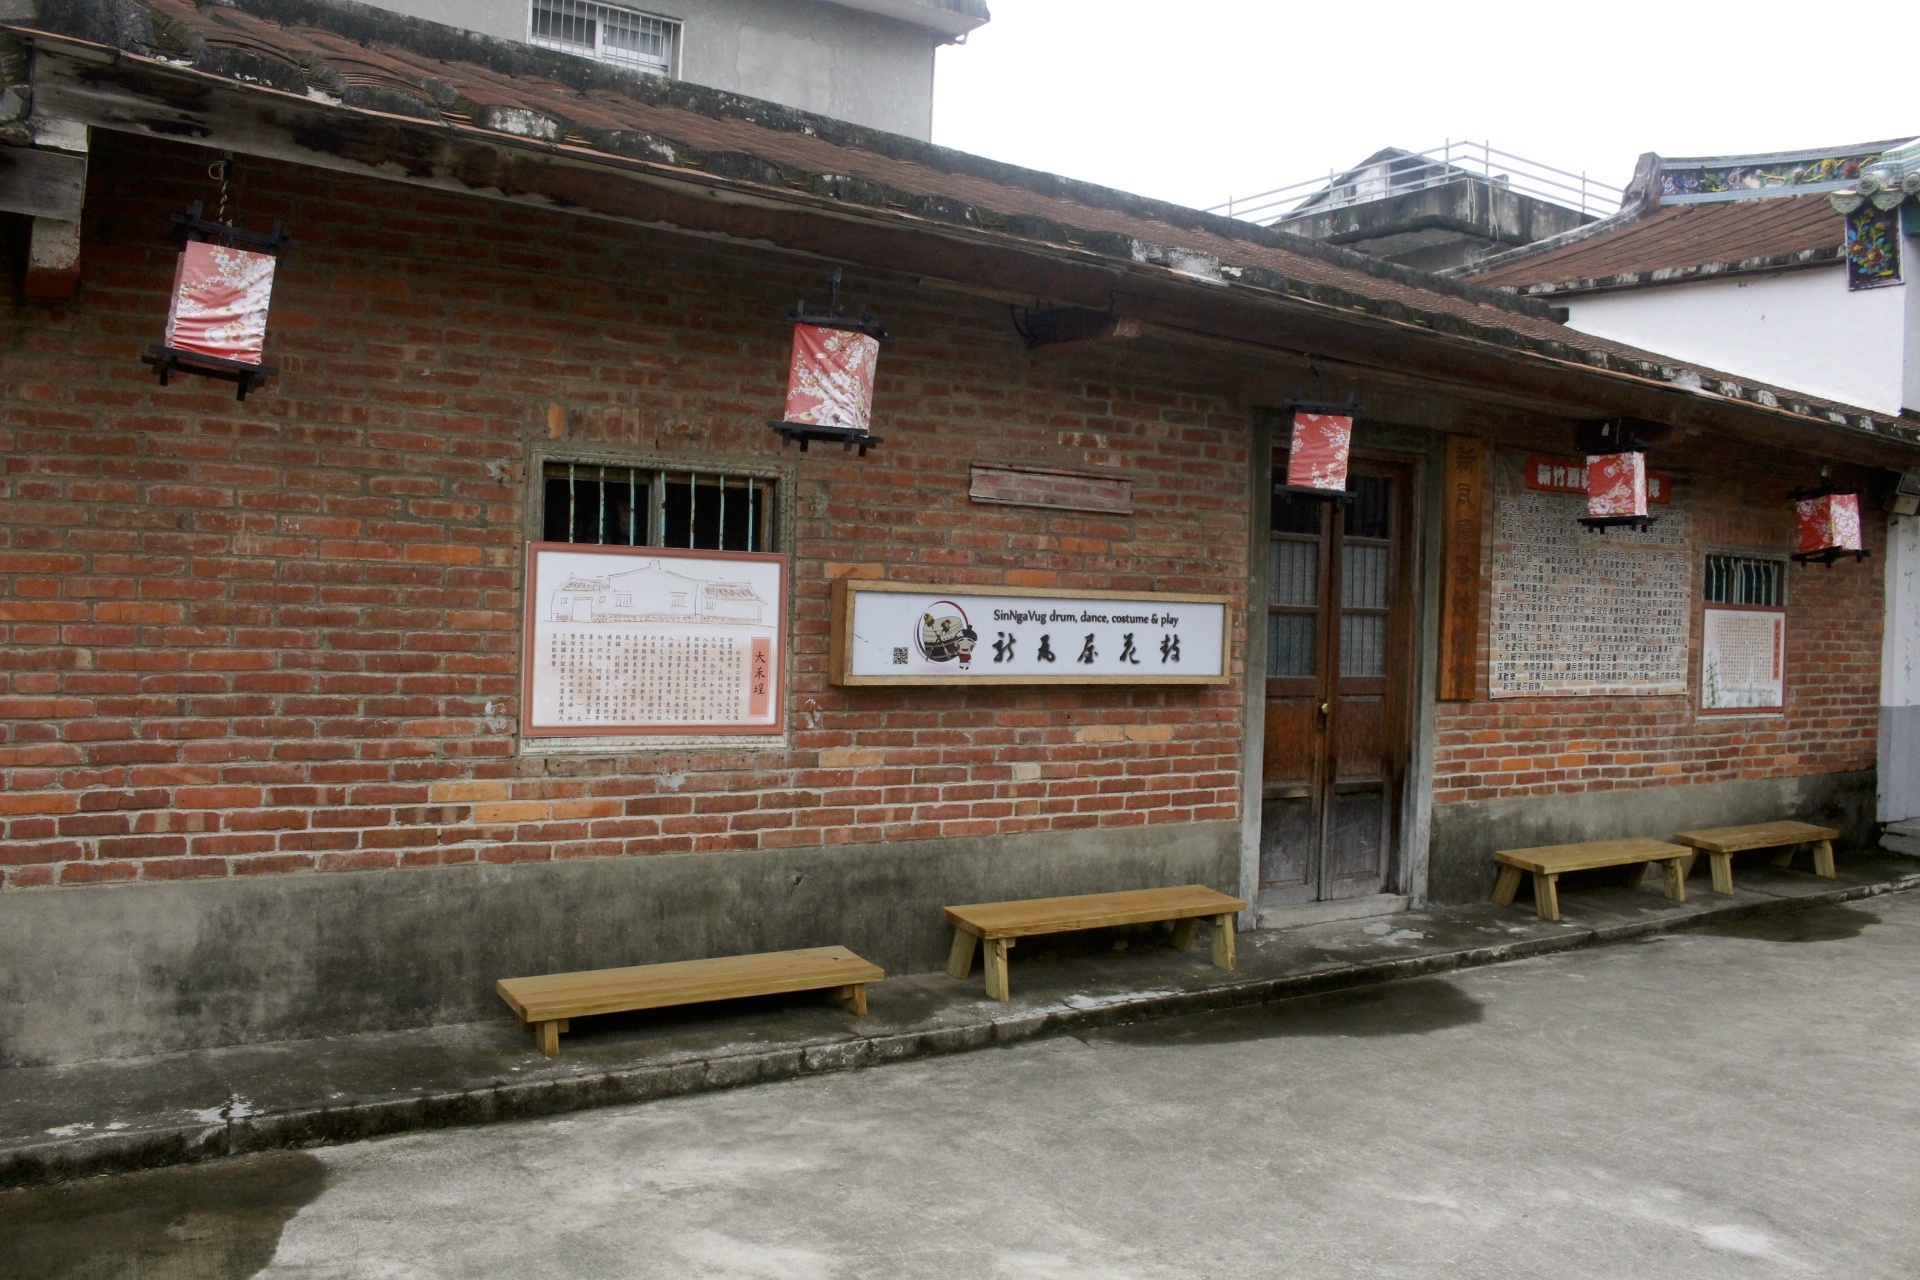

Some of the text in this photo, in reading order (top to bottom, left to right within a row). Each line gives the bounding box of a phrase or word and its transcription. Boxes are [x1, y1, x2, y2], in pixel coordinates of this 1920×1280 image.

[993, 609, 1179, 628] SinNgaVug drum, dance, costume & play
[753, 650, 766, 695] 大禾埕
